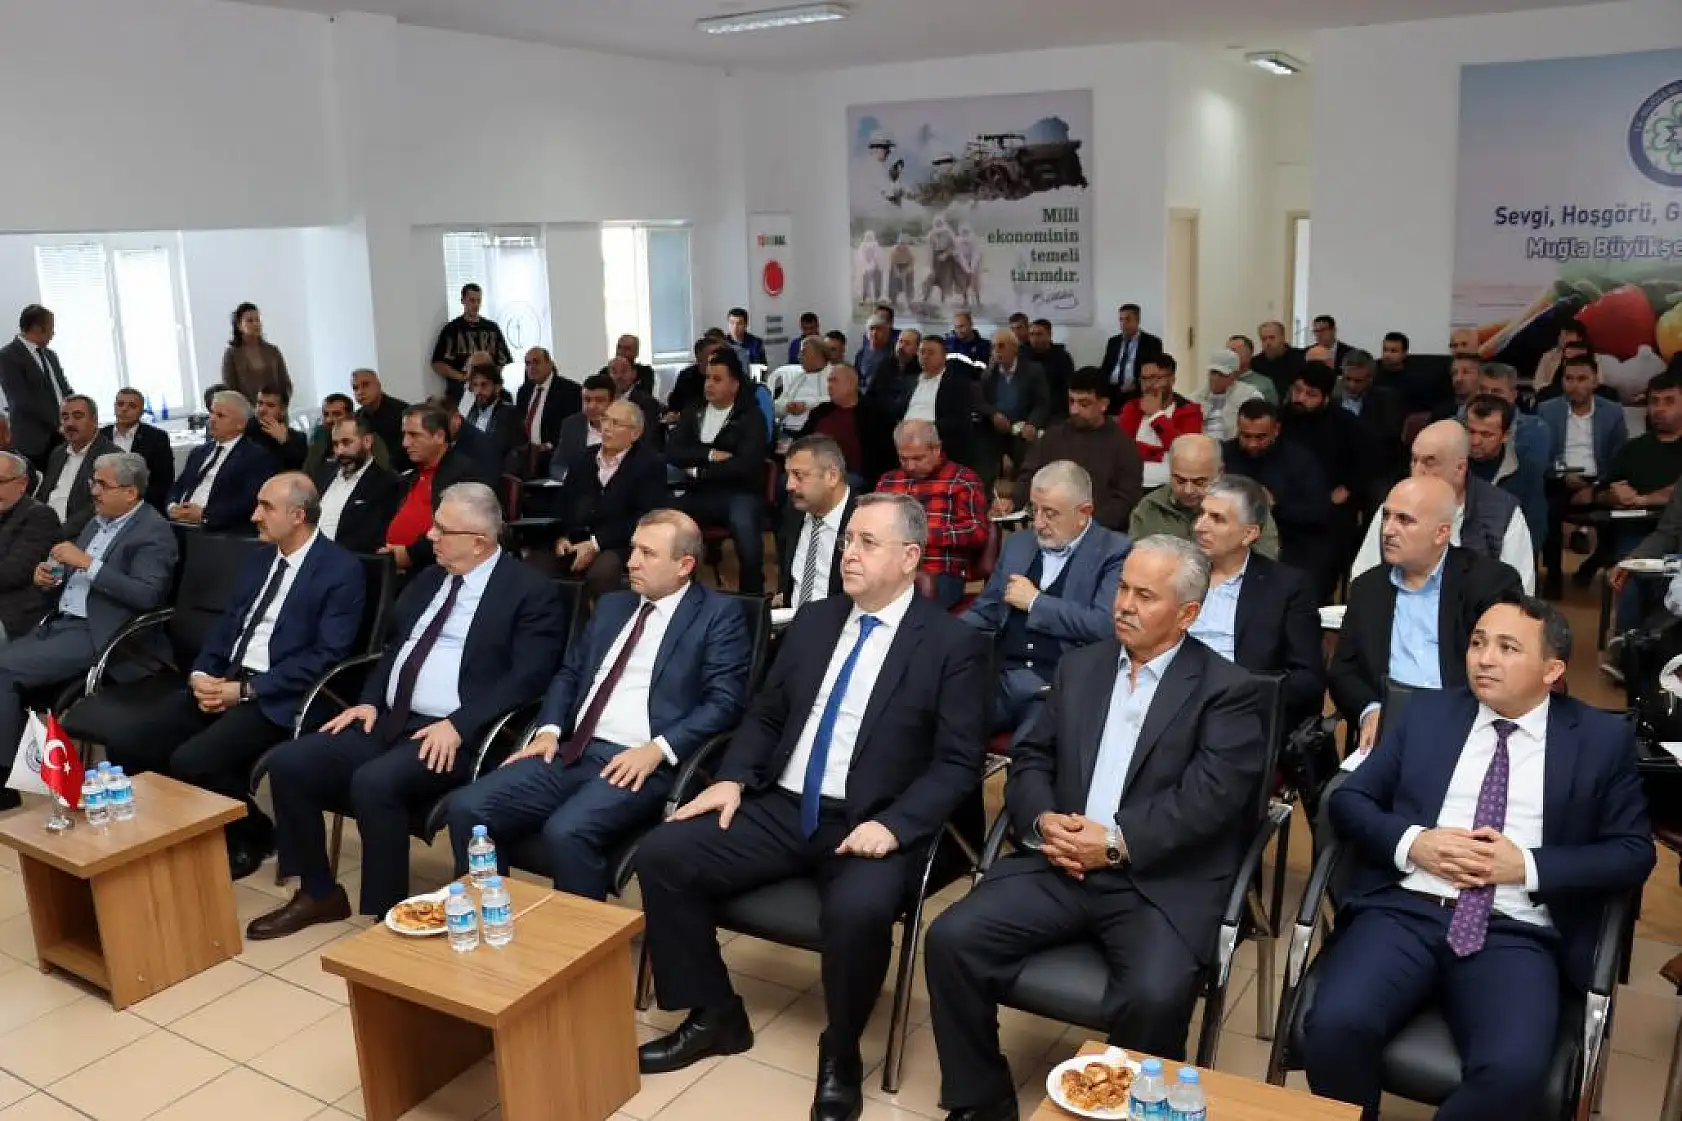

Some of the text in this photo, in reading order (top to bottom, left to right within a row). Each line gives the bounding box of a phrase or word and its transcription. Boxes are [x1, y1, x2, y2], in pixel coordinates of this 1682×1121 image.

[1042, 207, 1080, 223] Milli
[1494, 205, 1555, 229] Sevgi,
[1562, 201, 1657, 228] Hoşgörü,
[987, 228, 1080, 243] ekonominin
[1030, 248, 1080, 263] temeli
[1526, 236, 1591, 262] Muğla
[1010, 267, 1080, 282] tarımdır.
